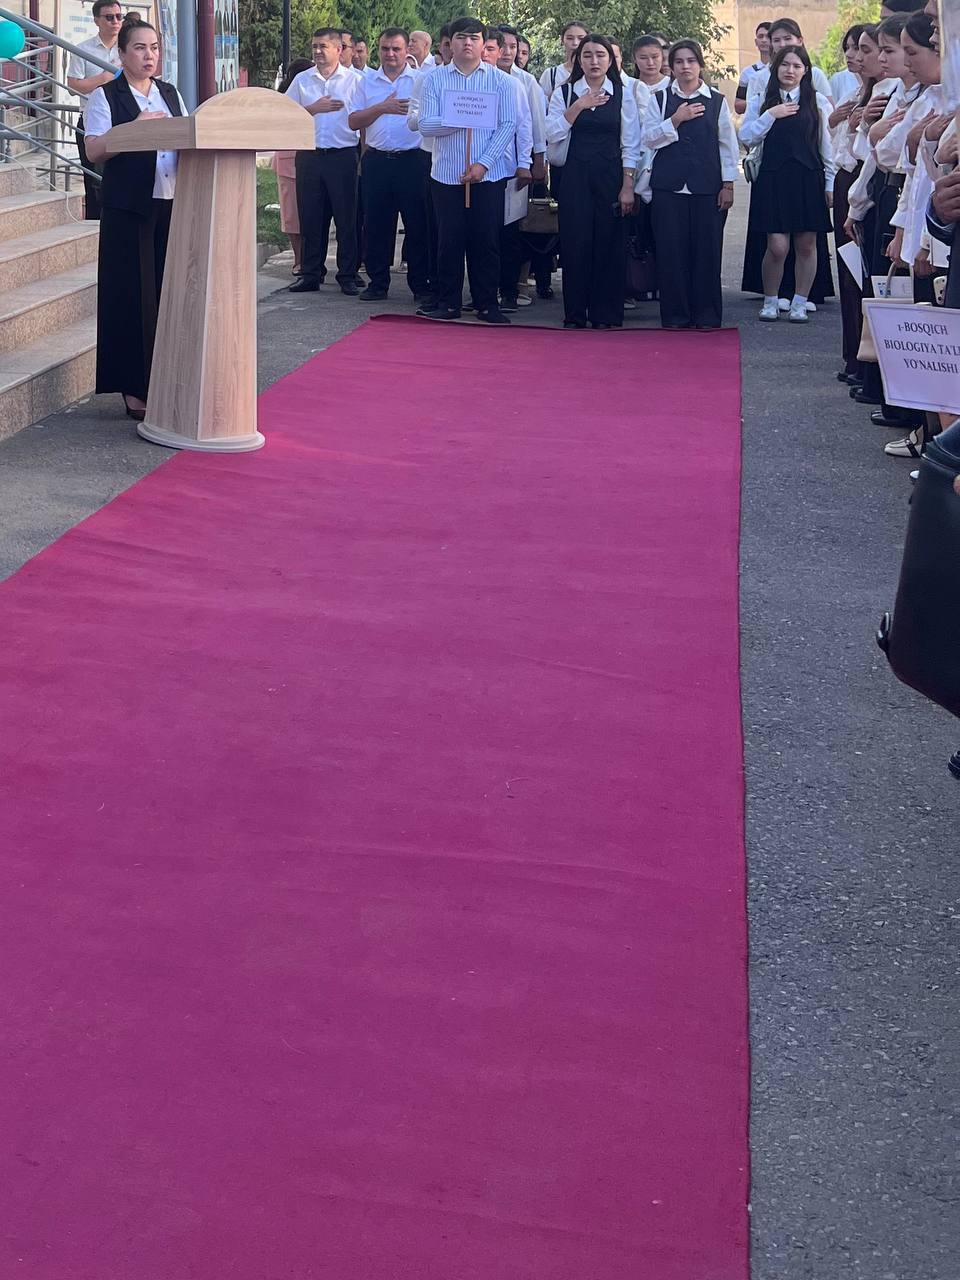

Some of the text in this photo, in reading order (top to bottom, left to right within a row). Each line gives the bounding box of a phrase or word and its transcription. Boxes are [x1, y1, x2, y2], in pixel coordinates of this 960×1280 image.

[897, 322, 949, 336] 1-BOSQICH
[883, 339, 937, 354] BIOLOGIYA
[903, 358, 959, 374] YO'NALISHI
